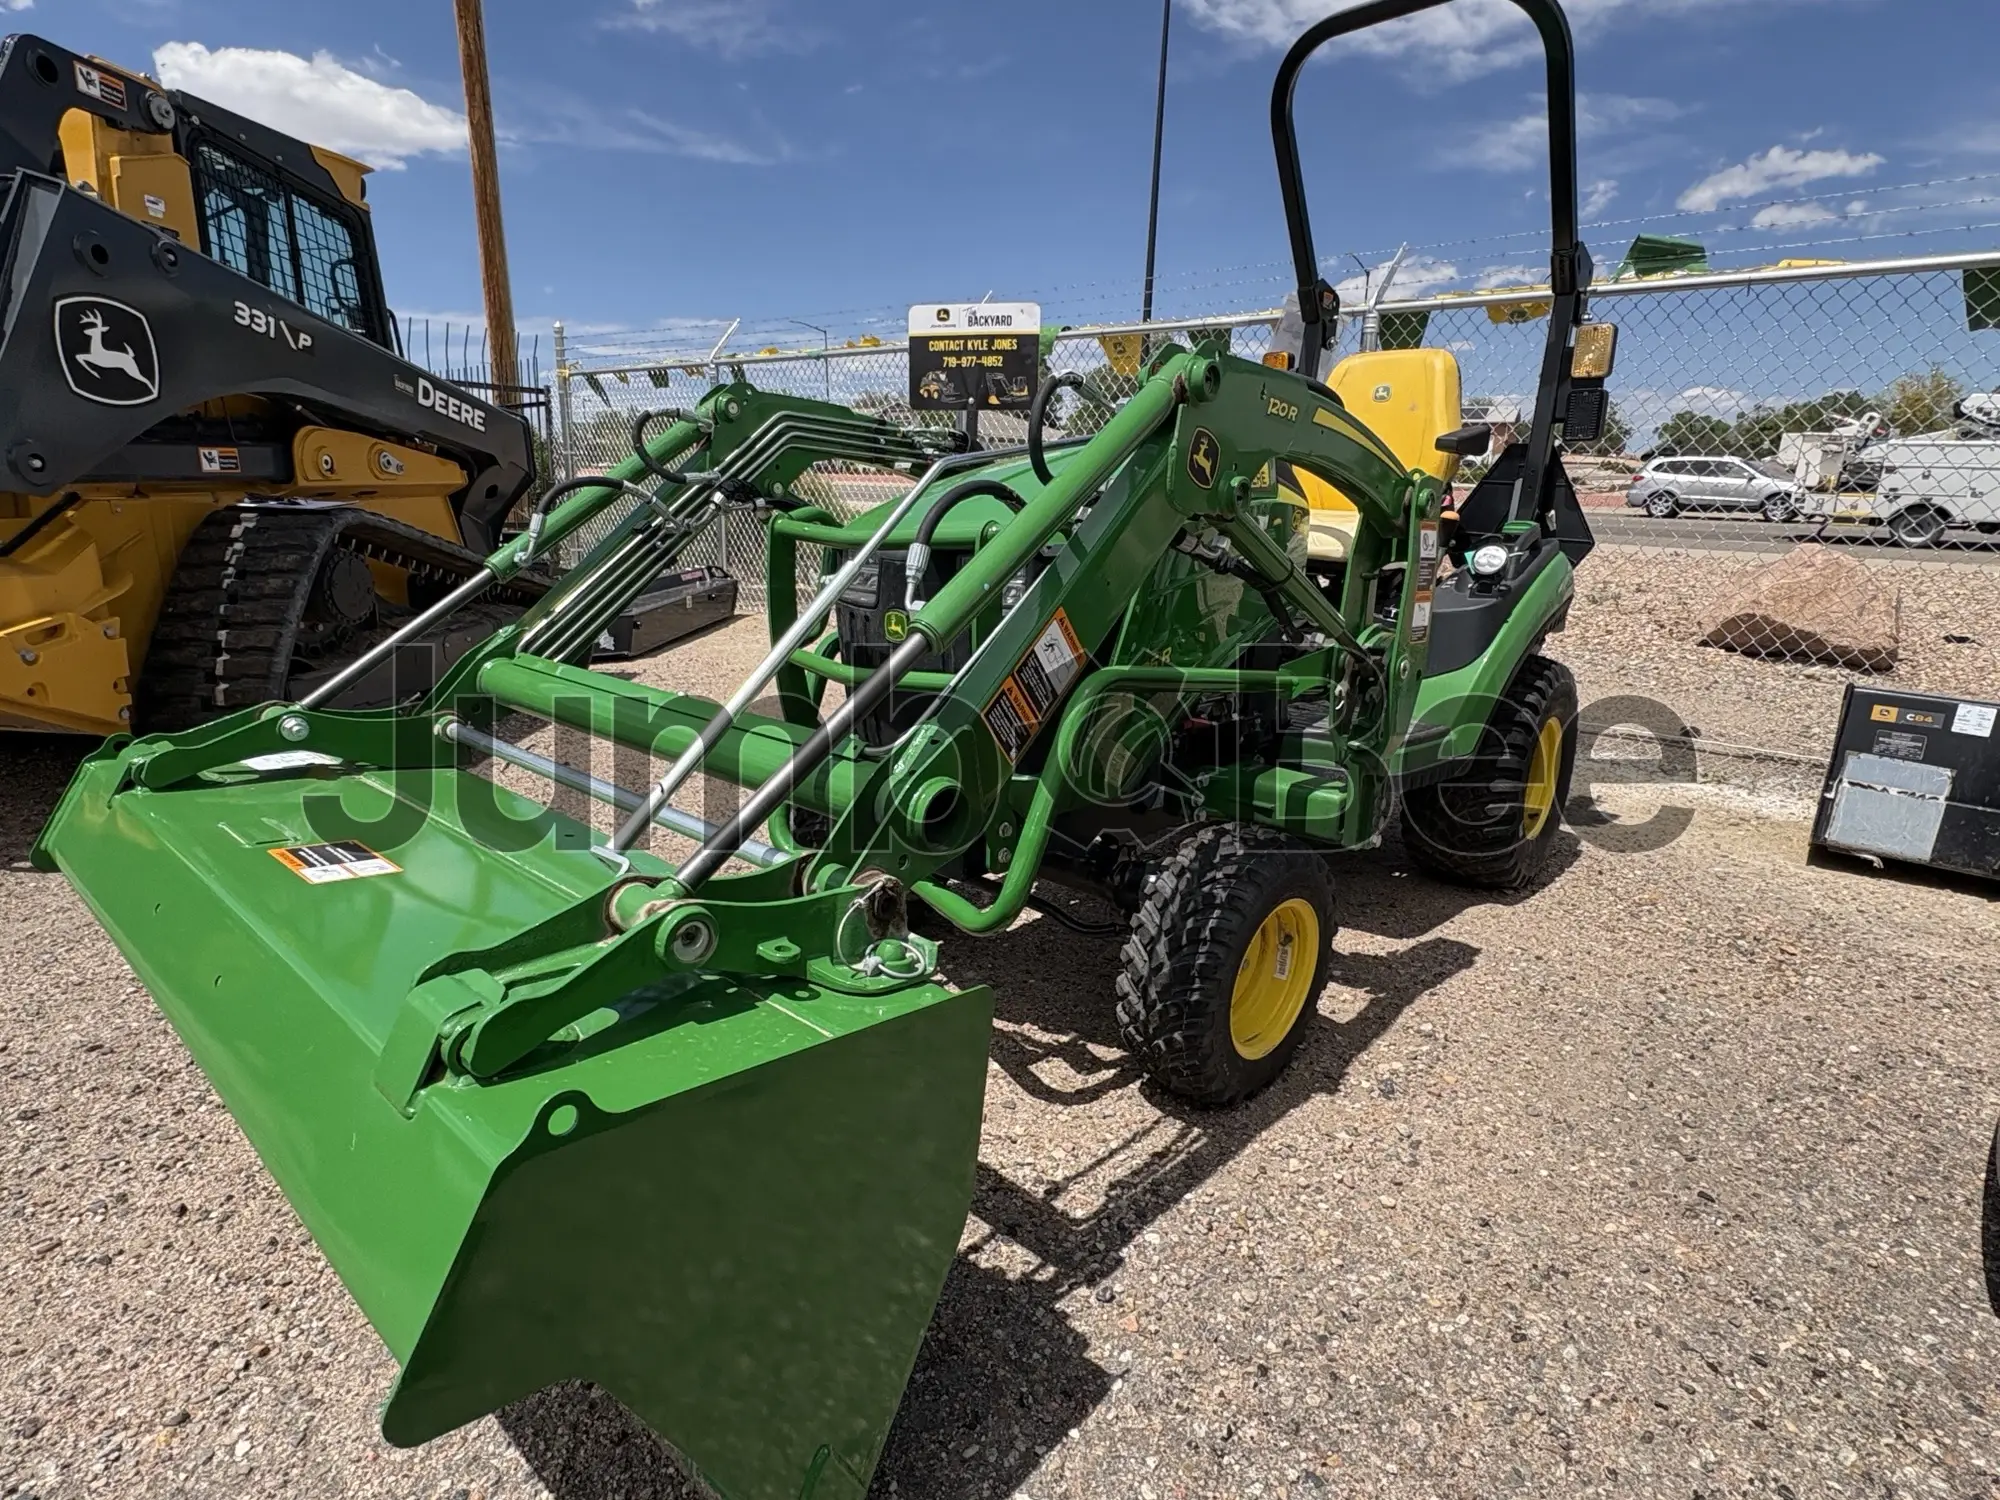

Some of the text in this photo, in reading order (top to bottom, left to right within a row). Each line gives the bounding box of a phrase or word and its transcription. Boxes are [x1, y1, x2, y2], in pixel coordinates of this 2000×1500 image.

[968, 315, 1012, 327] BACKYARD
[928, 338, 1018, 351] CONTACT KYLE JONES
[942, 356, 1004, 367] 719-977-4852
[417, 377, 486, 432] DEERE
